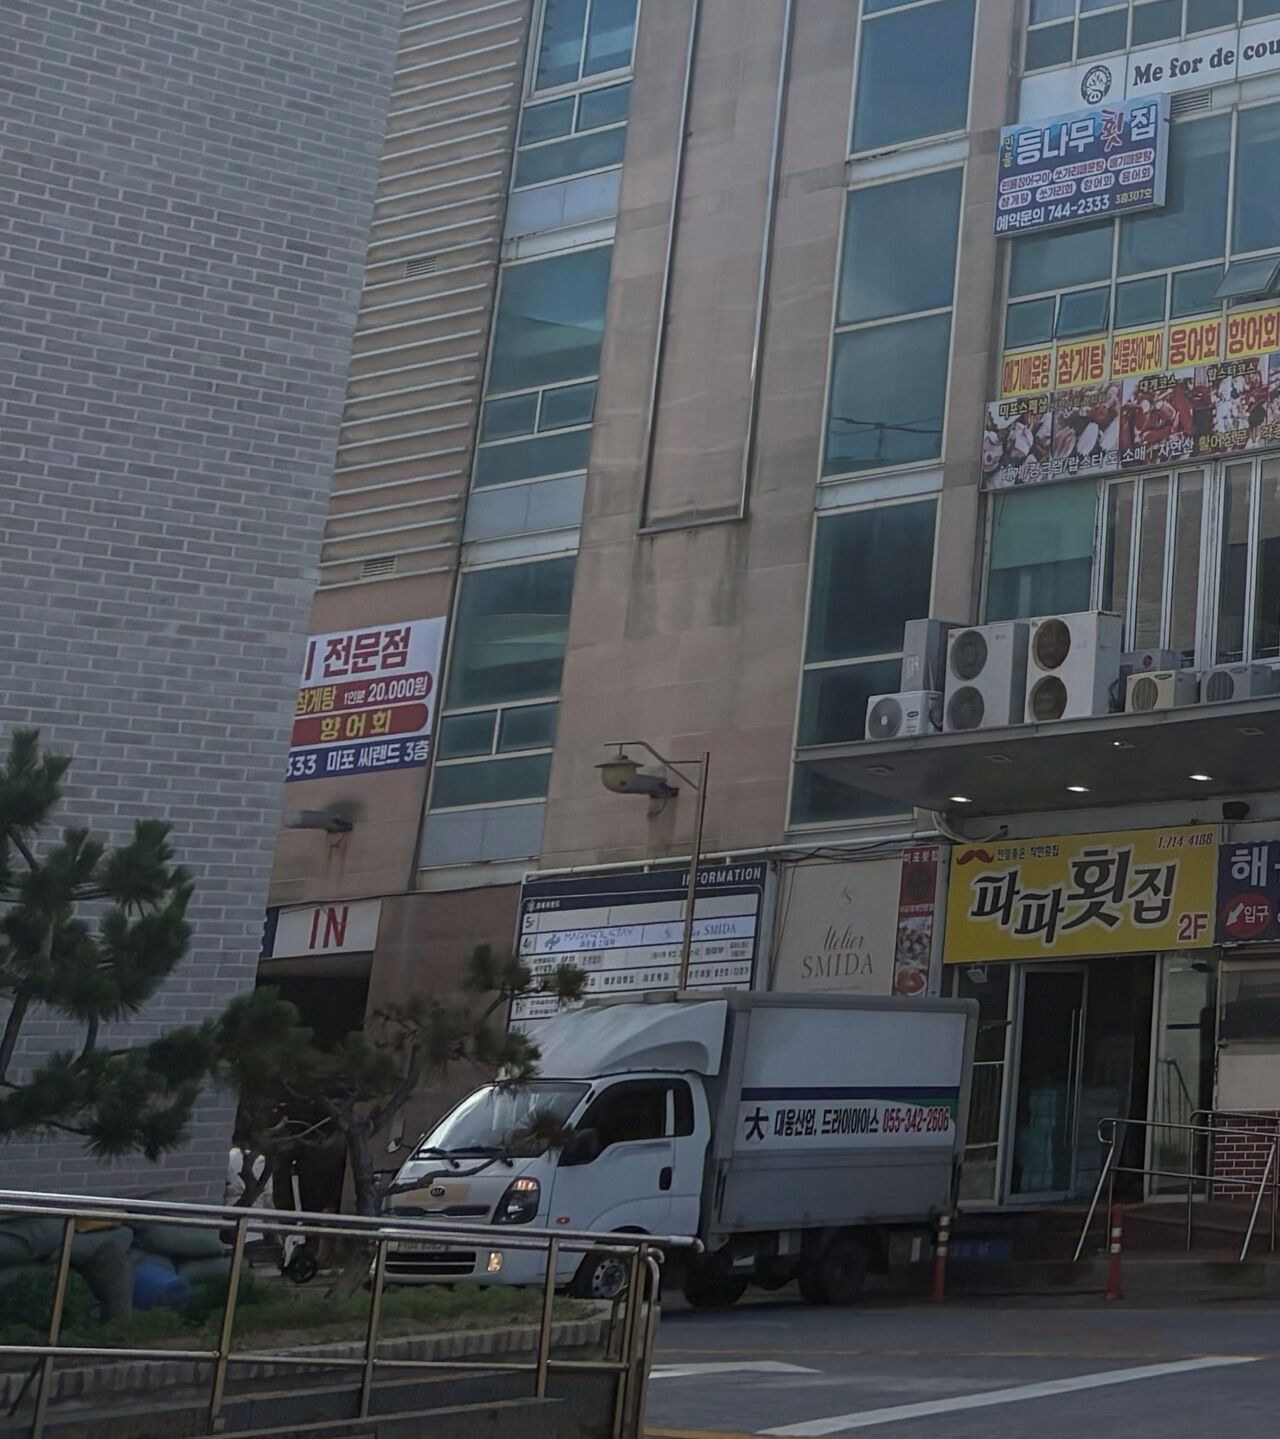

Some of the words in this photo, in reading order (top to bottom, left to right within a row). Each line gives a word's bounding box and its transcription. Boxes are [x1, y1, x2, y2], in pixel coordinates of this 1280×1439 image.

[1132, 63, 1164, 87] Me
[1168, 58, 1204, 79] for
[1209, 47, 1235, 70] de
[996, 208, 1044, 232] 예약문의
[1048, 194, 1110, 221] 744-2333
[1003, 353, 1051, 393] 메기매운탕
[1057, 343, 1105, 385] 참게탕
[1112, 333, 1163, 380] 민물장어구이
[1169, 322, 1221, 365] 웅어회
[1228, 310, 1280, 354] 향어회
[323, 626, 412, 678] 전문점
[367, 675, 429, 703] 20.000원
[326, 749, 356, 772] 미포
[357, 743, 402, 767] 씨랜드
[404, 739, 430, 762] 3층
[970, 848, 1177, 945] 파파횟집
[310, 904, 349, 950] IN
[703, 923, 737, 936] SMIDA
[1177, 913, 1209, 942] 2F
[1243, 904, 1270, 924] 입구
[800, 952, 874, 980] SMIDA
[820, 1107, 880, 1135] 드라이아이스
[882, 1106, 950, 1134] 055-342-2606
